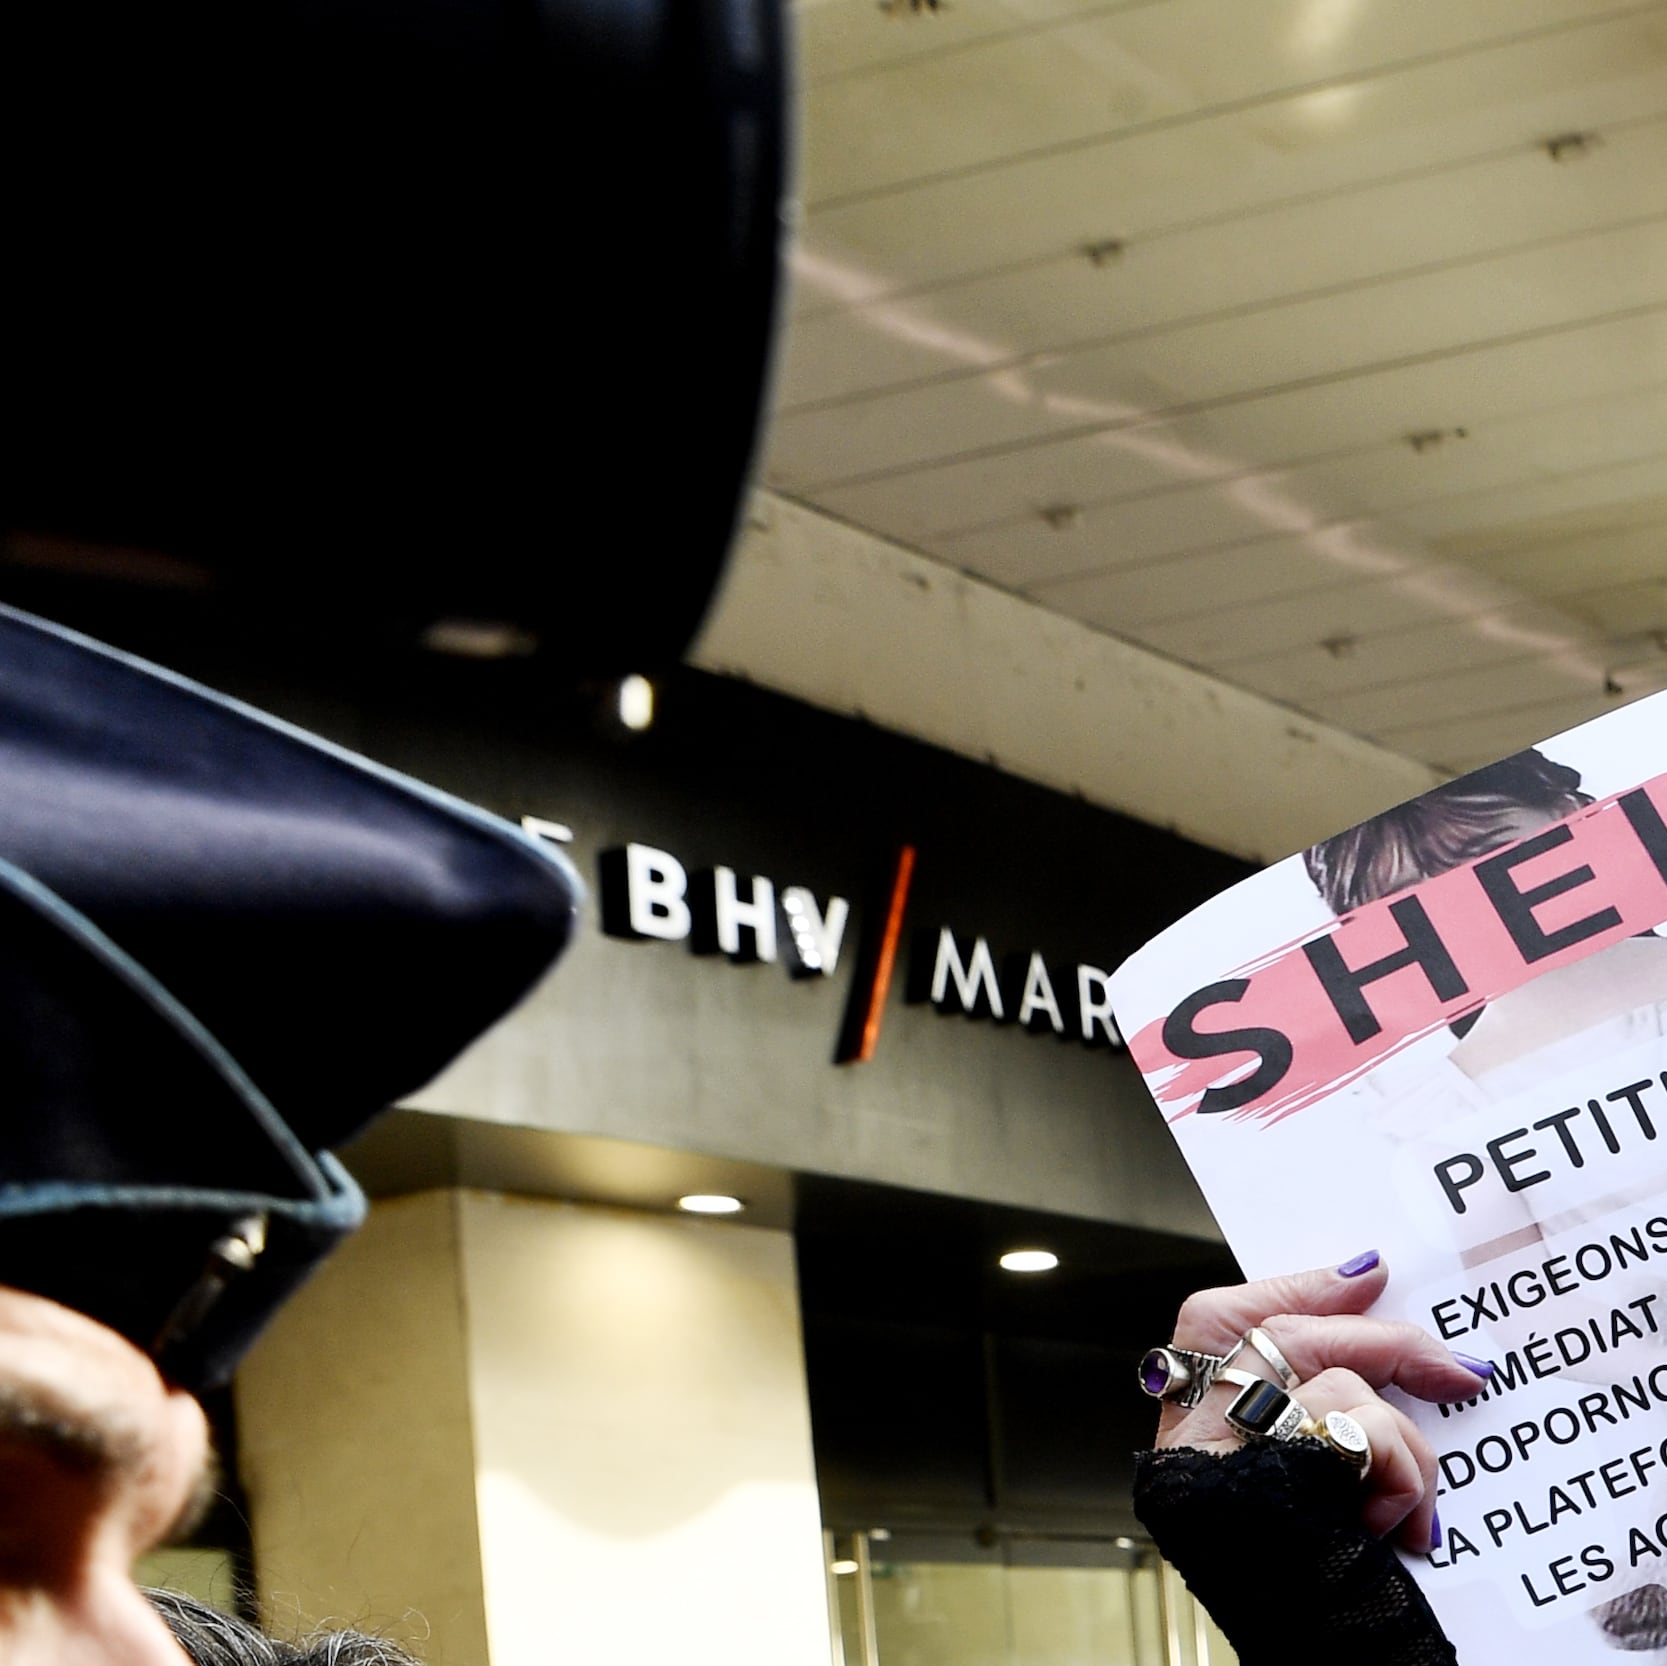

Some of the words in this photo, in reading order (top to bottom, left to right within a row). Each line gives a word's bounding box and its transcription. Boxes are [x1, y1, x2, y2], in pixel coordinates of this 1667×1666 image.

[627, 842, 849, 976] BHV
[931, 927, 1120, 1046] MAR
[1437, 1294, 1660, 1418] MÉDIAT
[1522, 1544, 1614, 1606] LES
